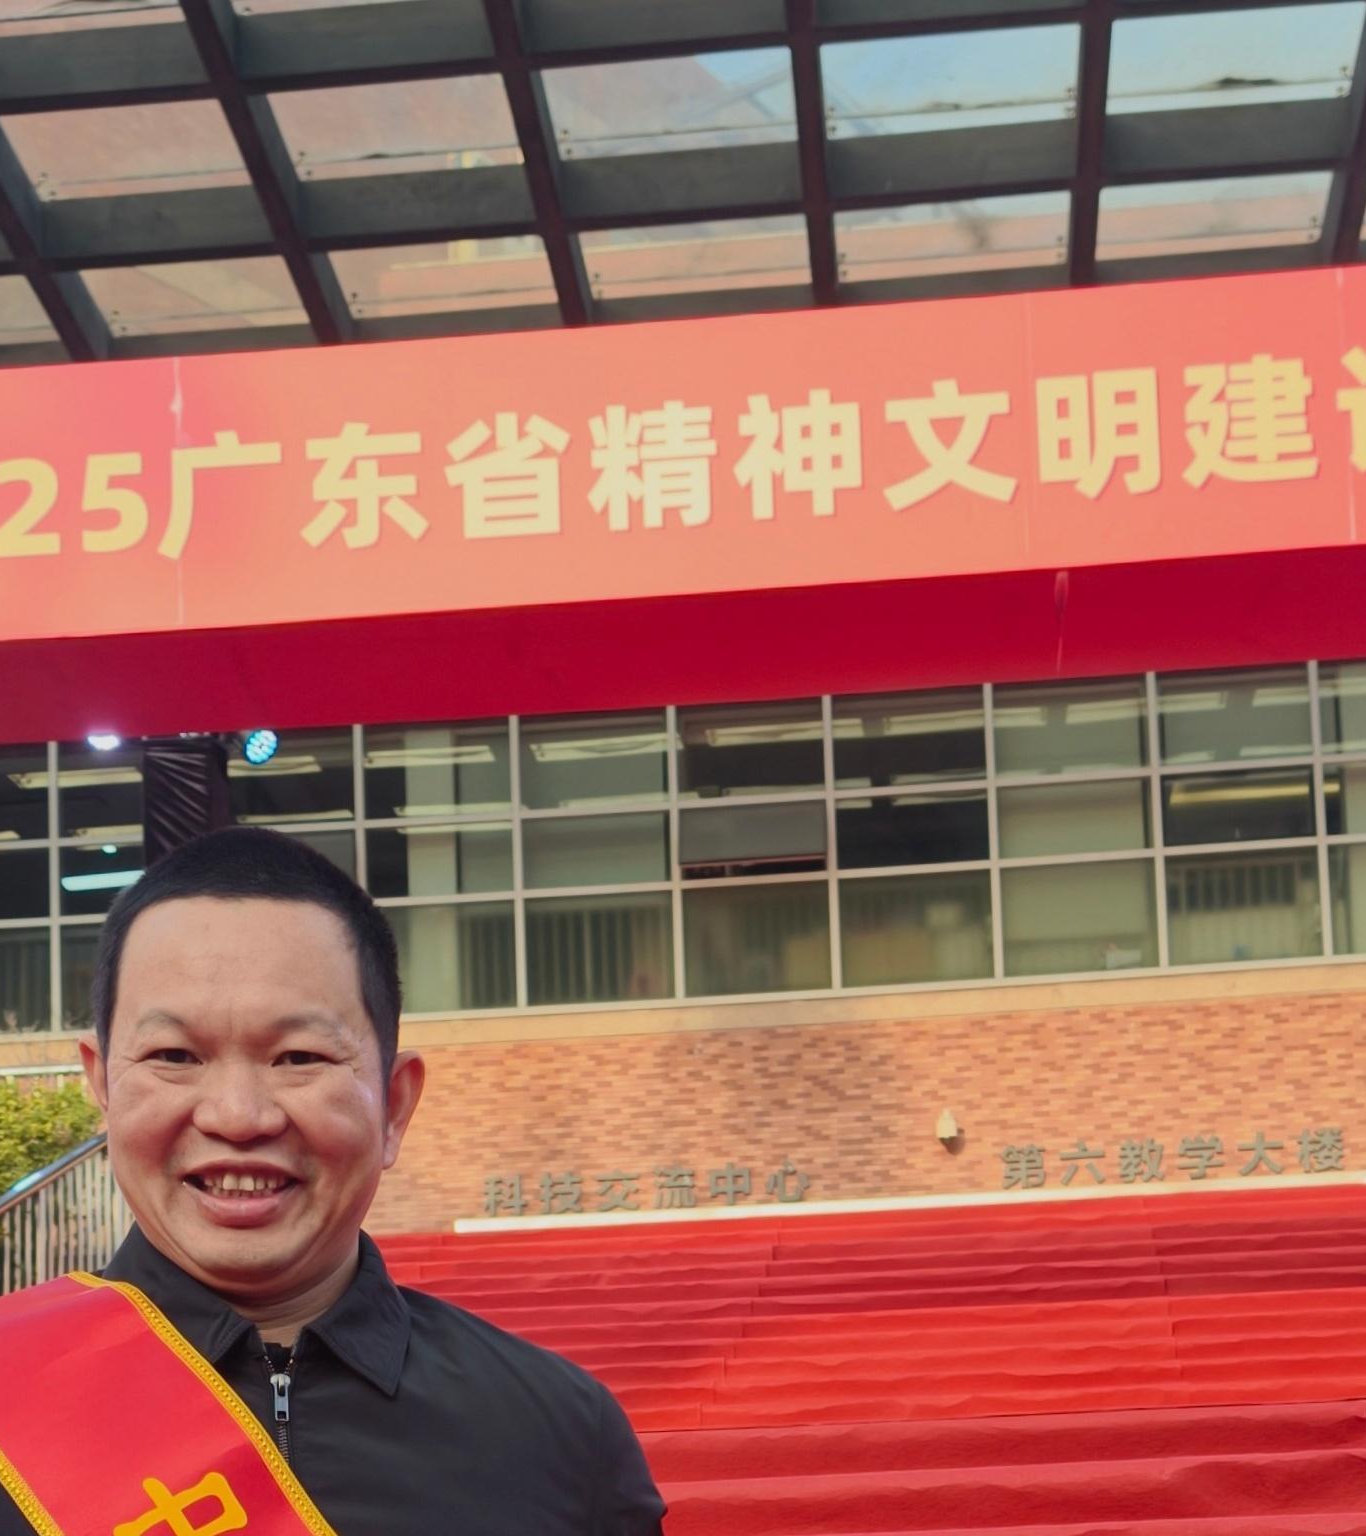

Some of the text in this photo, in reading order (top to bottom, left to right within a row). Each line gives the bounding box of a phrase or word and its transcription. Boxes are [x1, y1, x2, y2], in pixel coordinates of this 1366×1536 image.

[482, 1126, 1349, 1219] 科技交流中心 第六教学大楼
